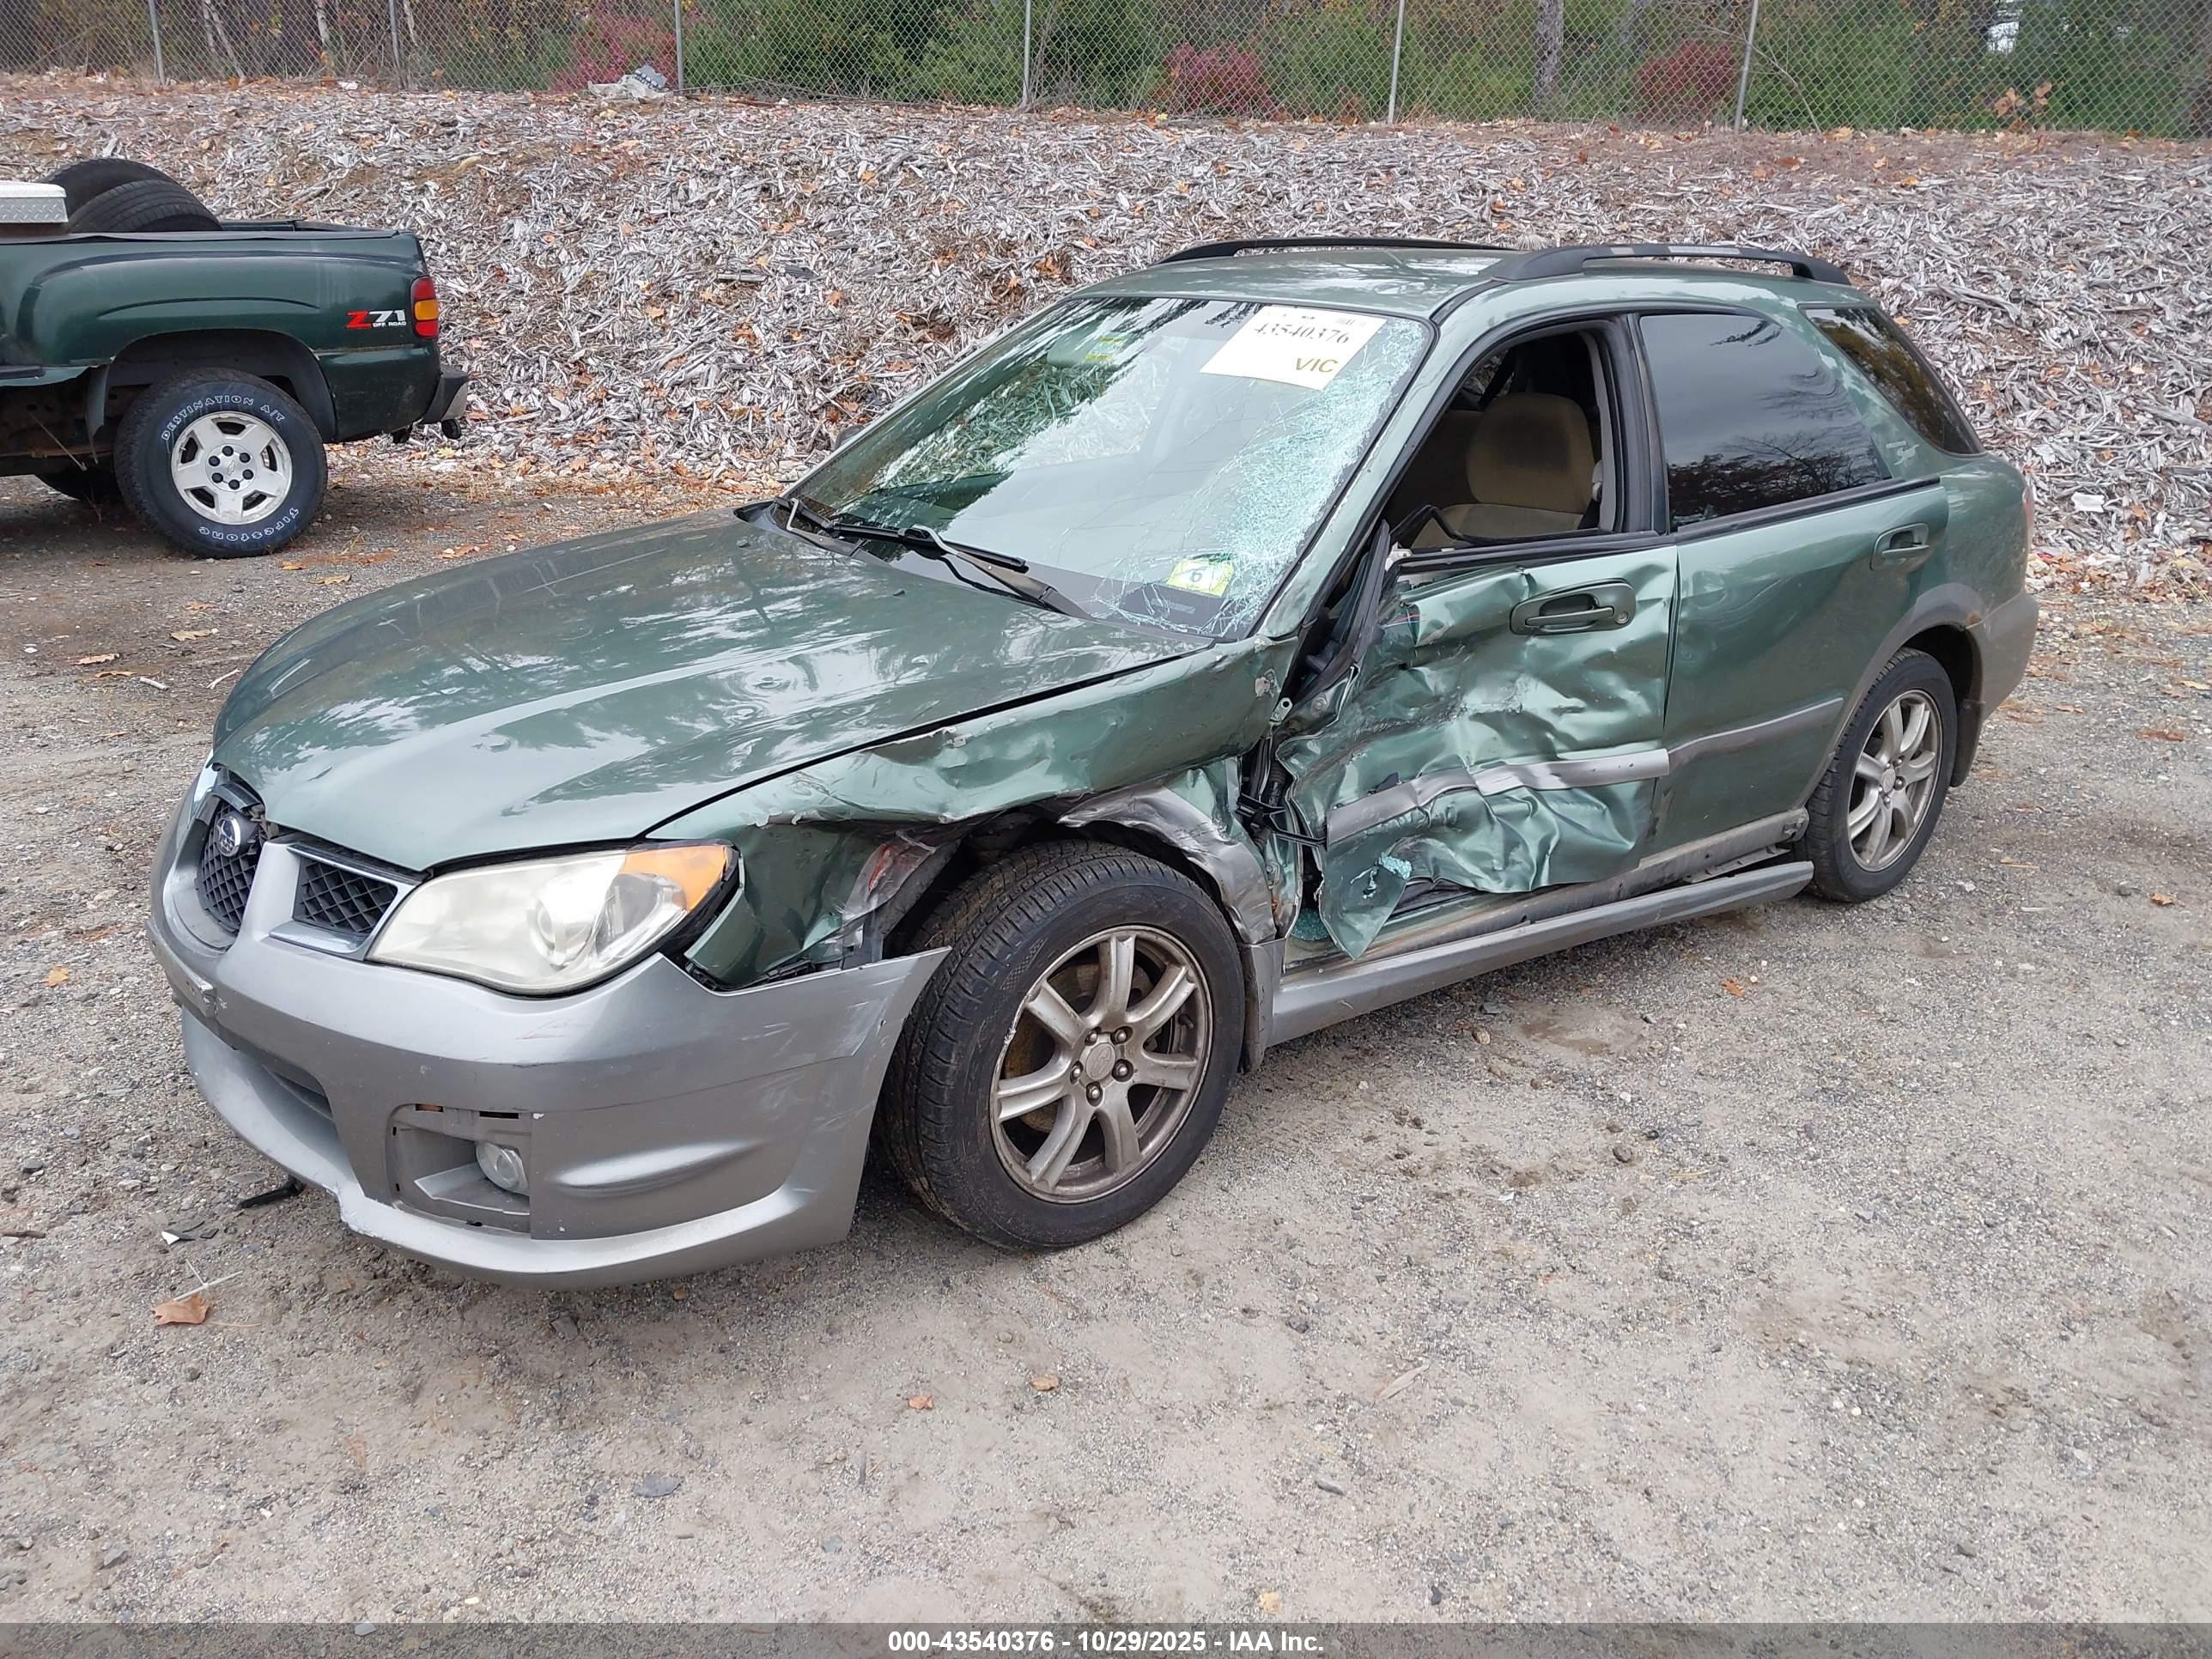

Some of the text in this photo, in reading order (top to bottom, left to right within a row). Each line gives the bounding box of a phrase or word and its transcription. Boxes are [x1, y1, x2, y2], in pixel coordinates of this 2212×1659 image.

[346, 309, 406, 329] Z71
[1255, 323, 1349, 343] 43540376
[1296, 358, 1338, 373] VIC
[161, 395, 286, 441] DESTINATION A/T
